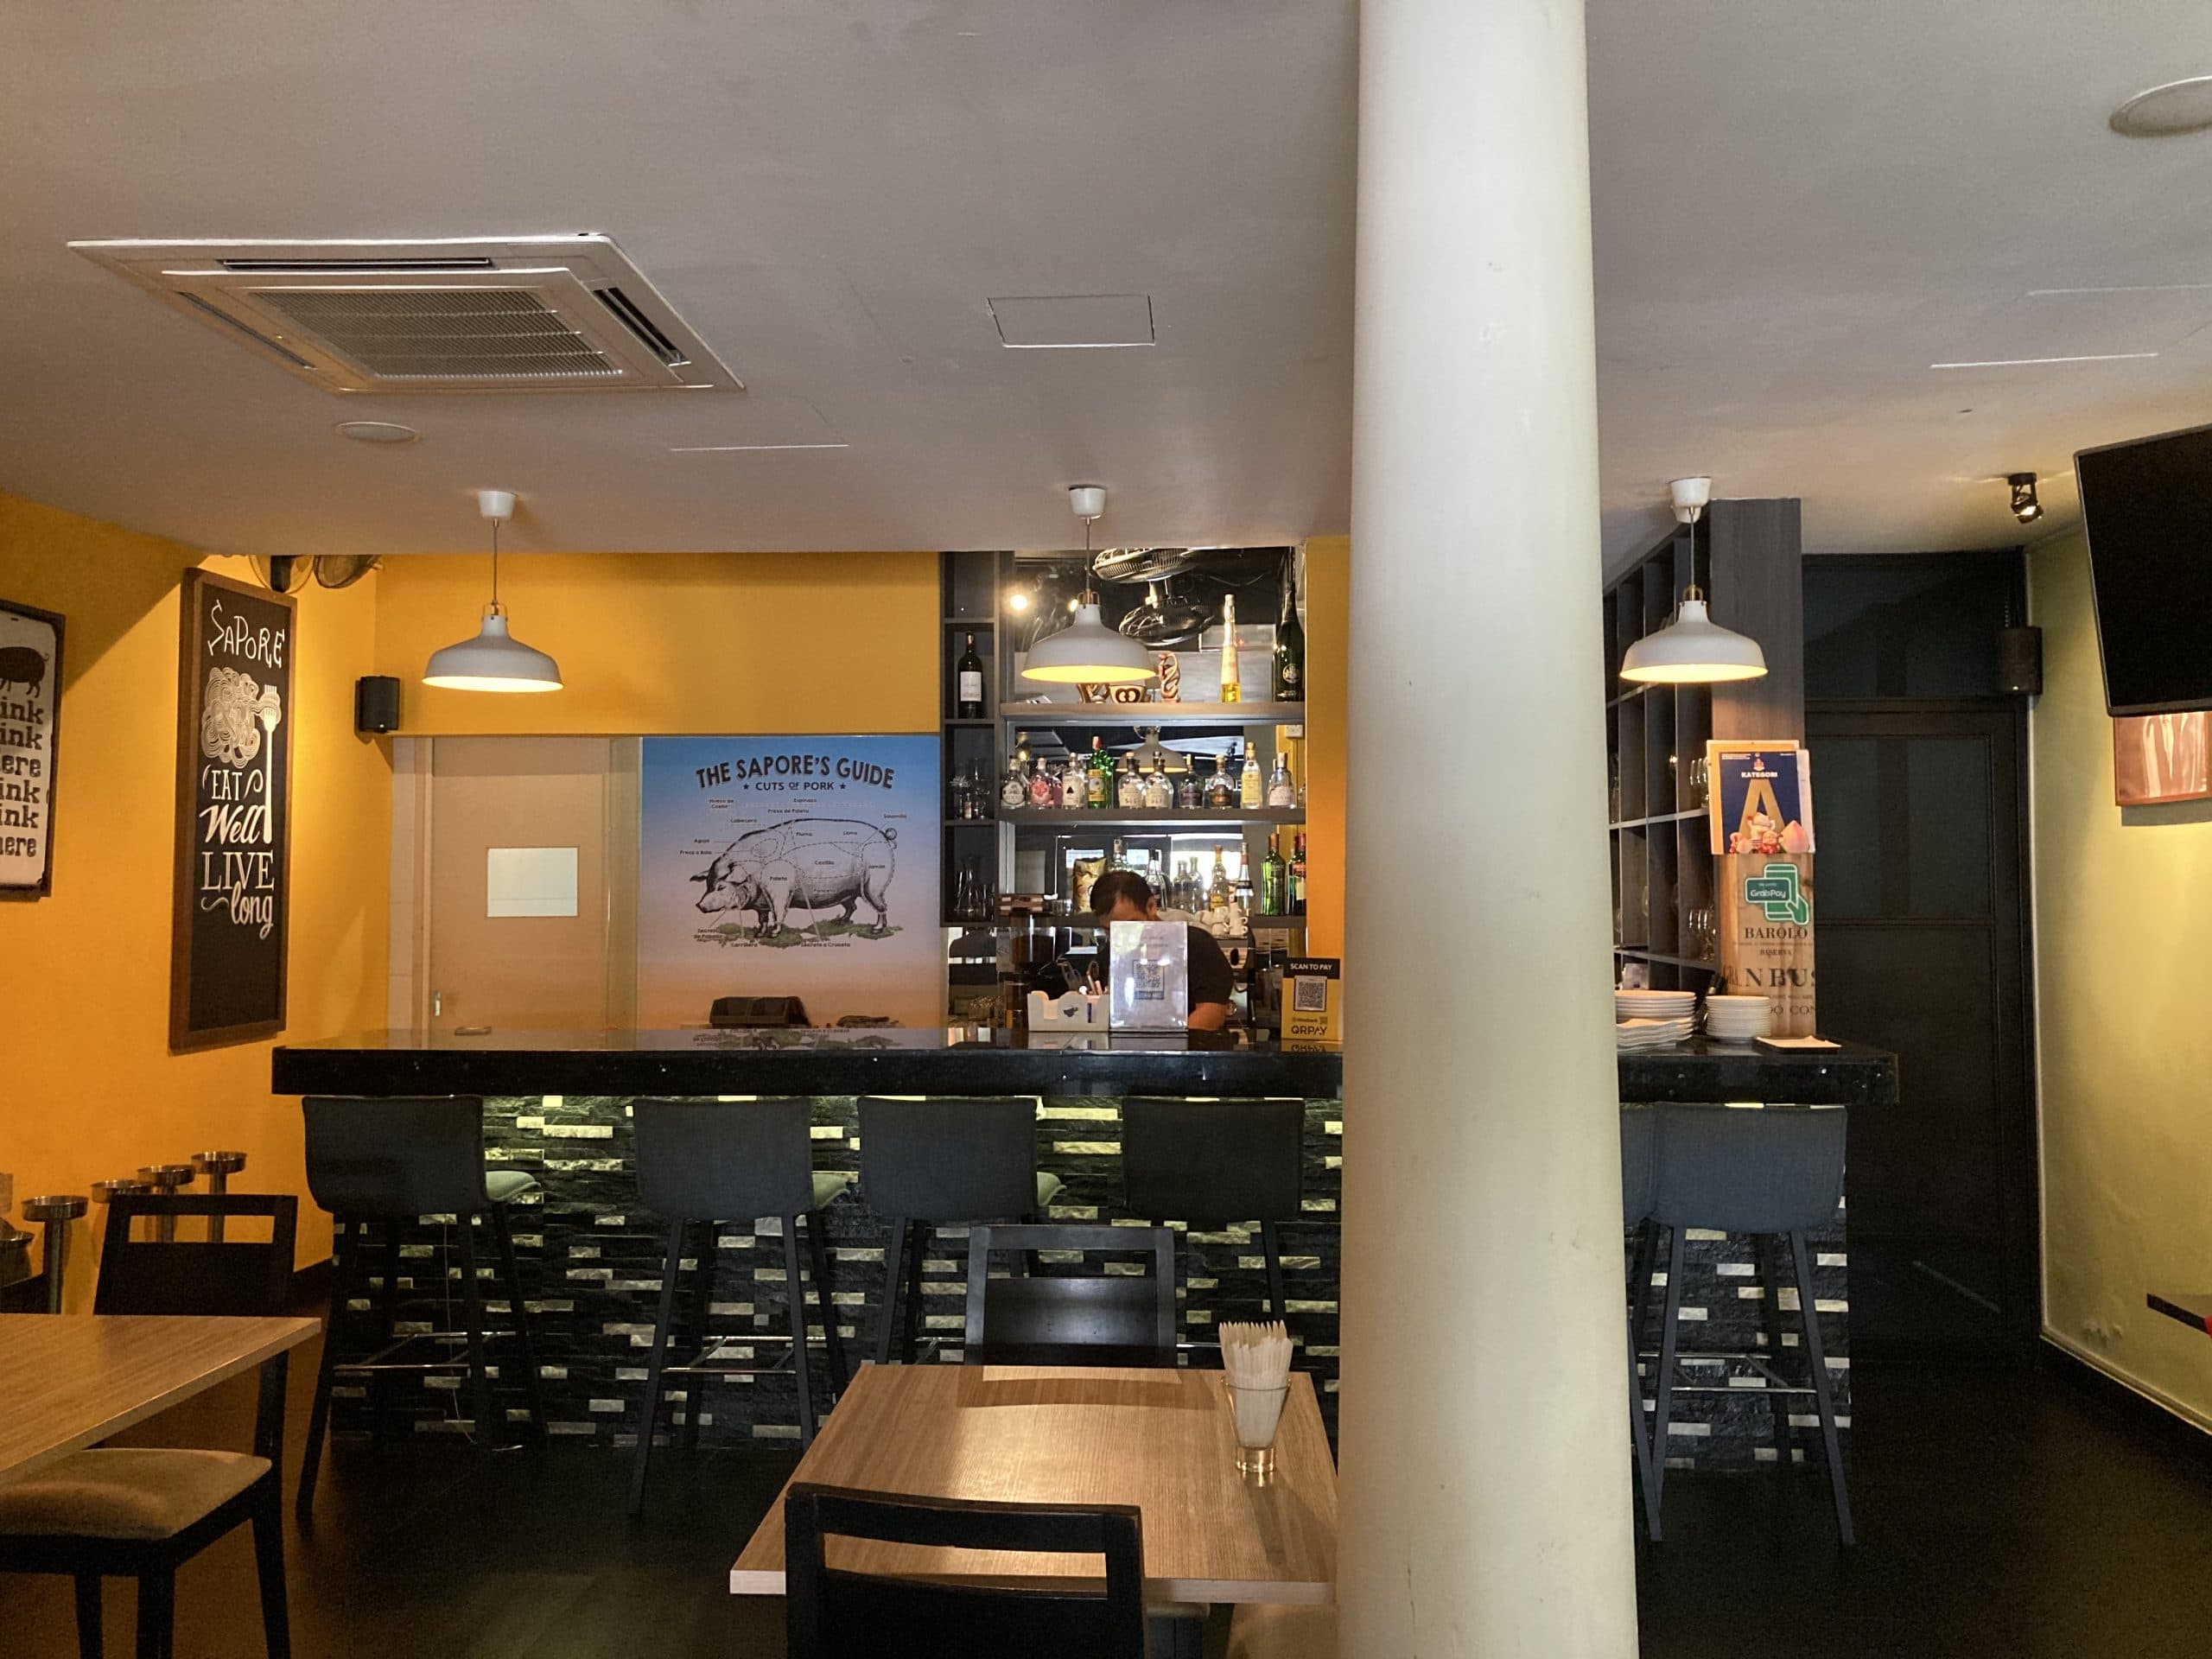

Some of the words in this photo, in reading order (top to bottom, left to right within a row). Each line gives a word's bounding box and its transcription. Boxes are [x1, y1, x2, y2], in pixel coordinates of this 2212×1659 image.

[207, 599, 286, 670] SAPORE
[0, 754, 41, 778] ere
[696, 762, 732, 789] THE
[736, 754, 831, 779] SAPORE'S
[836, 758, 895, 790] GUIDE
[211, 769, 243, 801] EAT
[755, 781, 785, 791] CUTS
[804, 781, 835, 791] PORK
[199, 804, 266, 845] Well
[200, 849, 276, 893] LIVE
[230, 880, 274, 940] long
[1750, 889, 1787, 899] GrabPay
[1745, 927, 1808, 939] BAROLO
[1291, 1025, 1327, 1036] QRPAY
